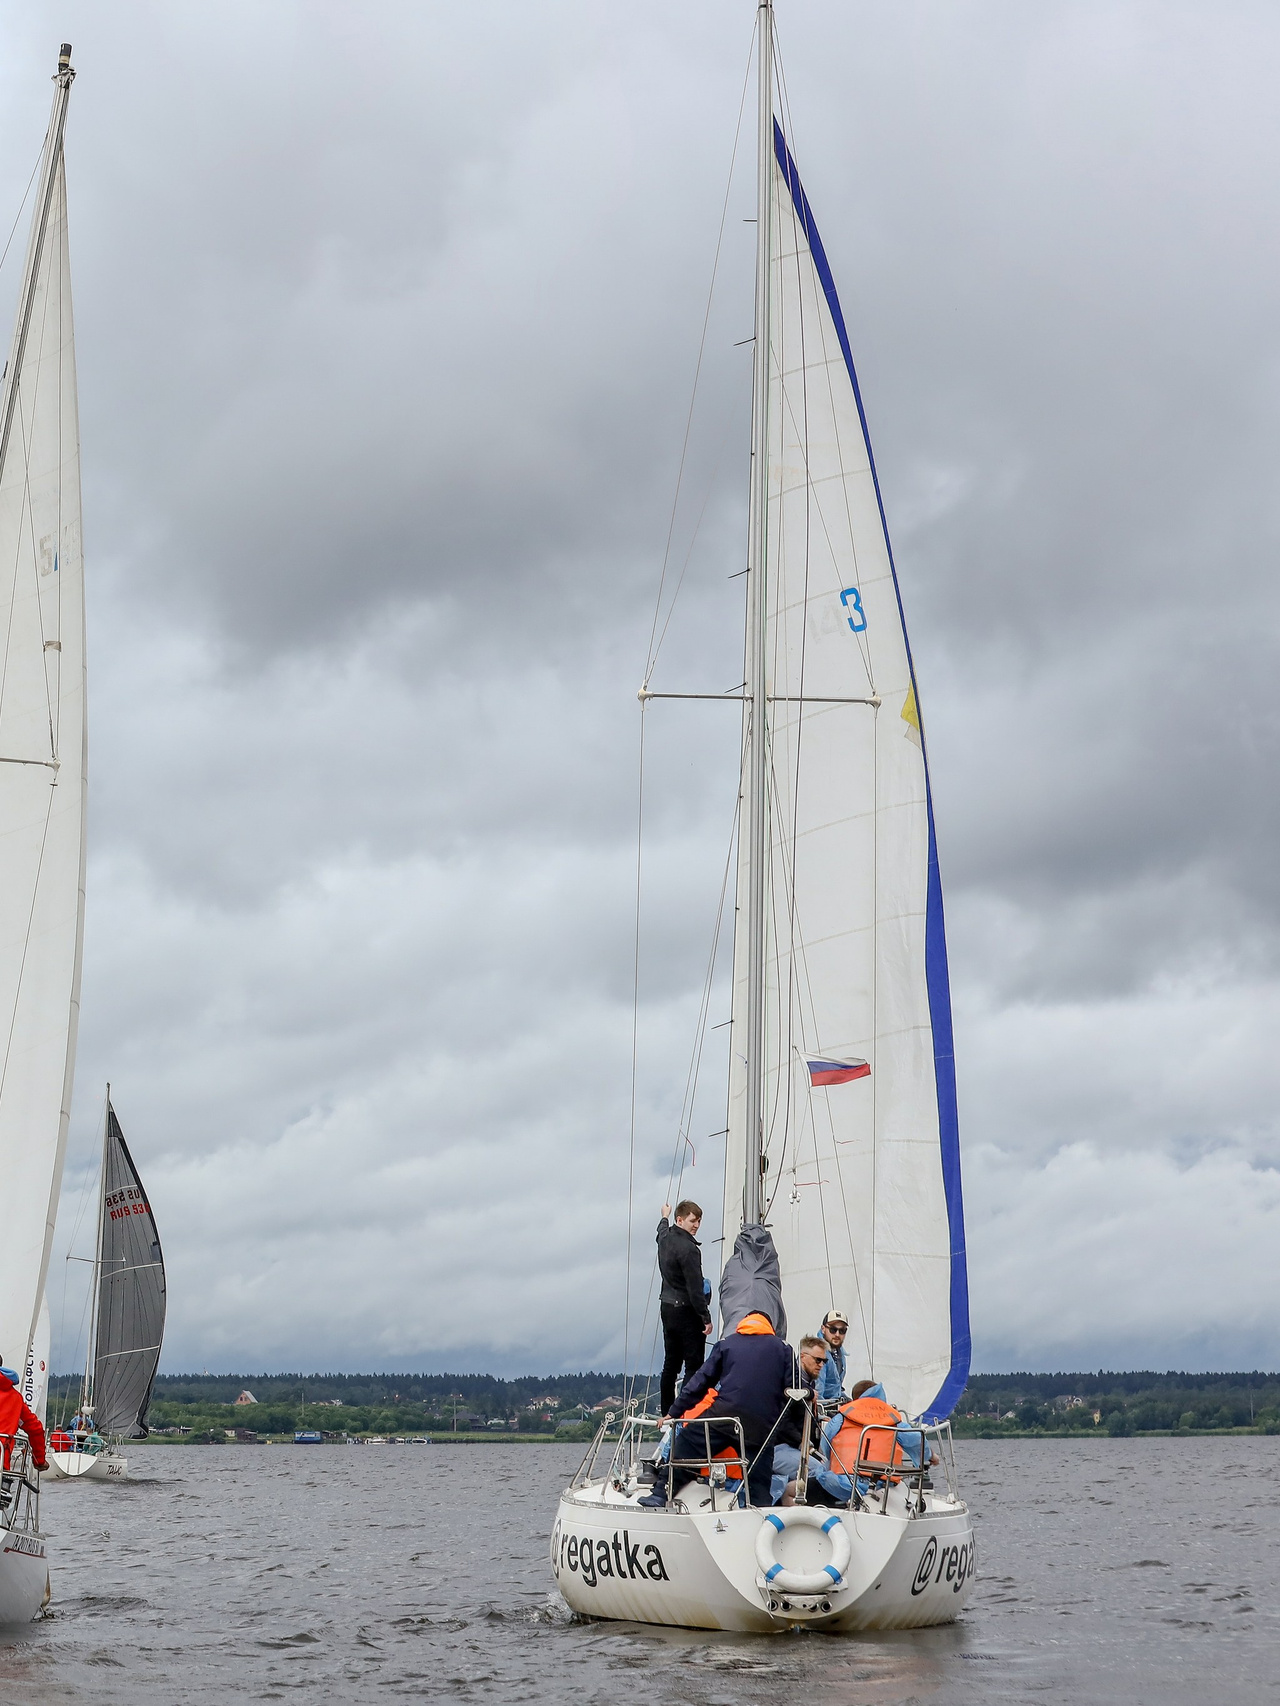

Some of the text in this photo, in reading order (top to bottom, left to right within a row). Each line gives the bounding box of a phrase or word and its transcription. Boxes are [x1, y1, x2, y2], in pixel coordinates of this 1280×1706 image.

[839, 587, 868, 633] 3
[110, 1206, 130, 1220] RUS
[910, 1532, 975, 1597] @rega
